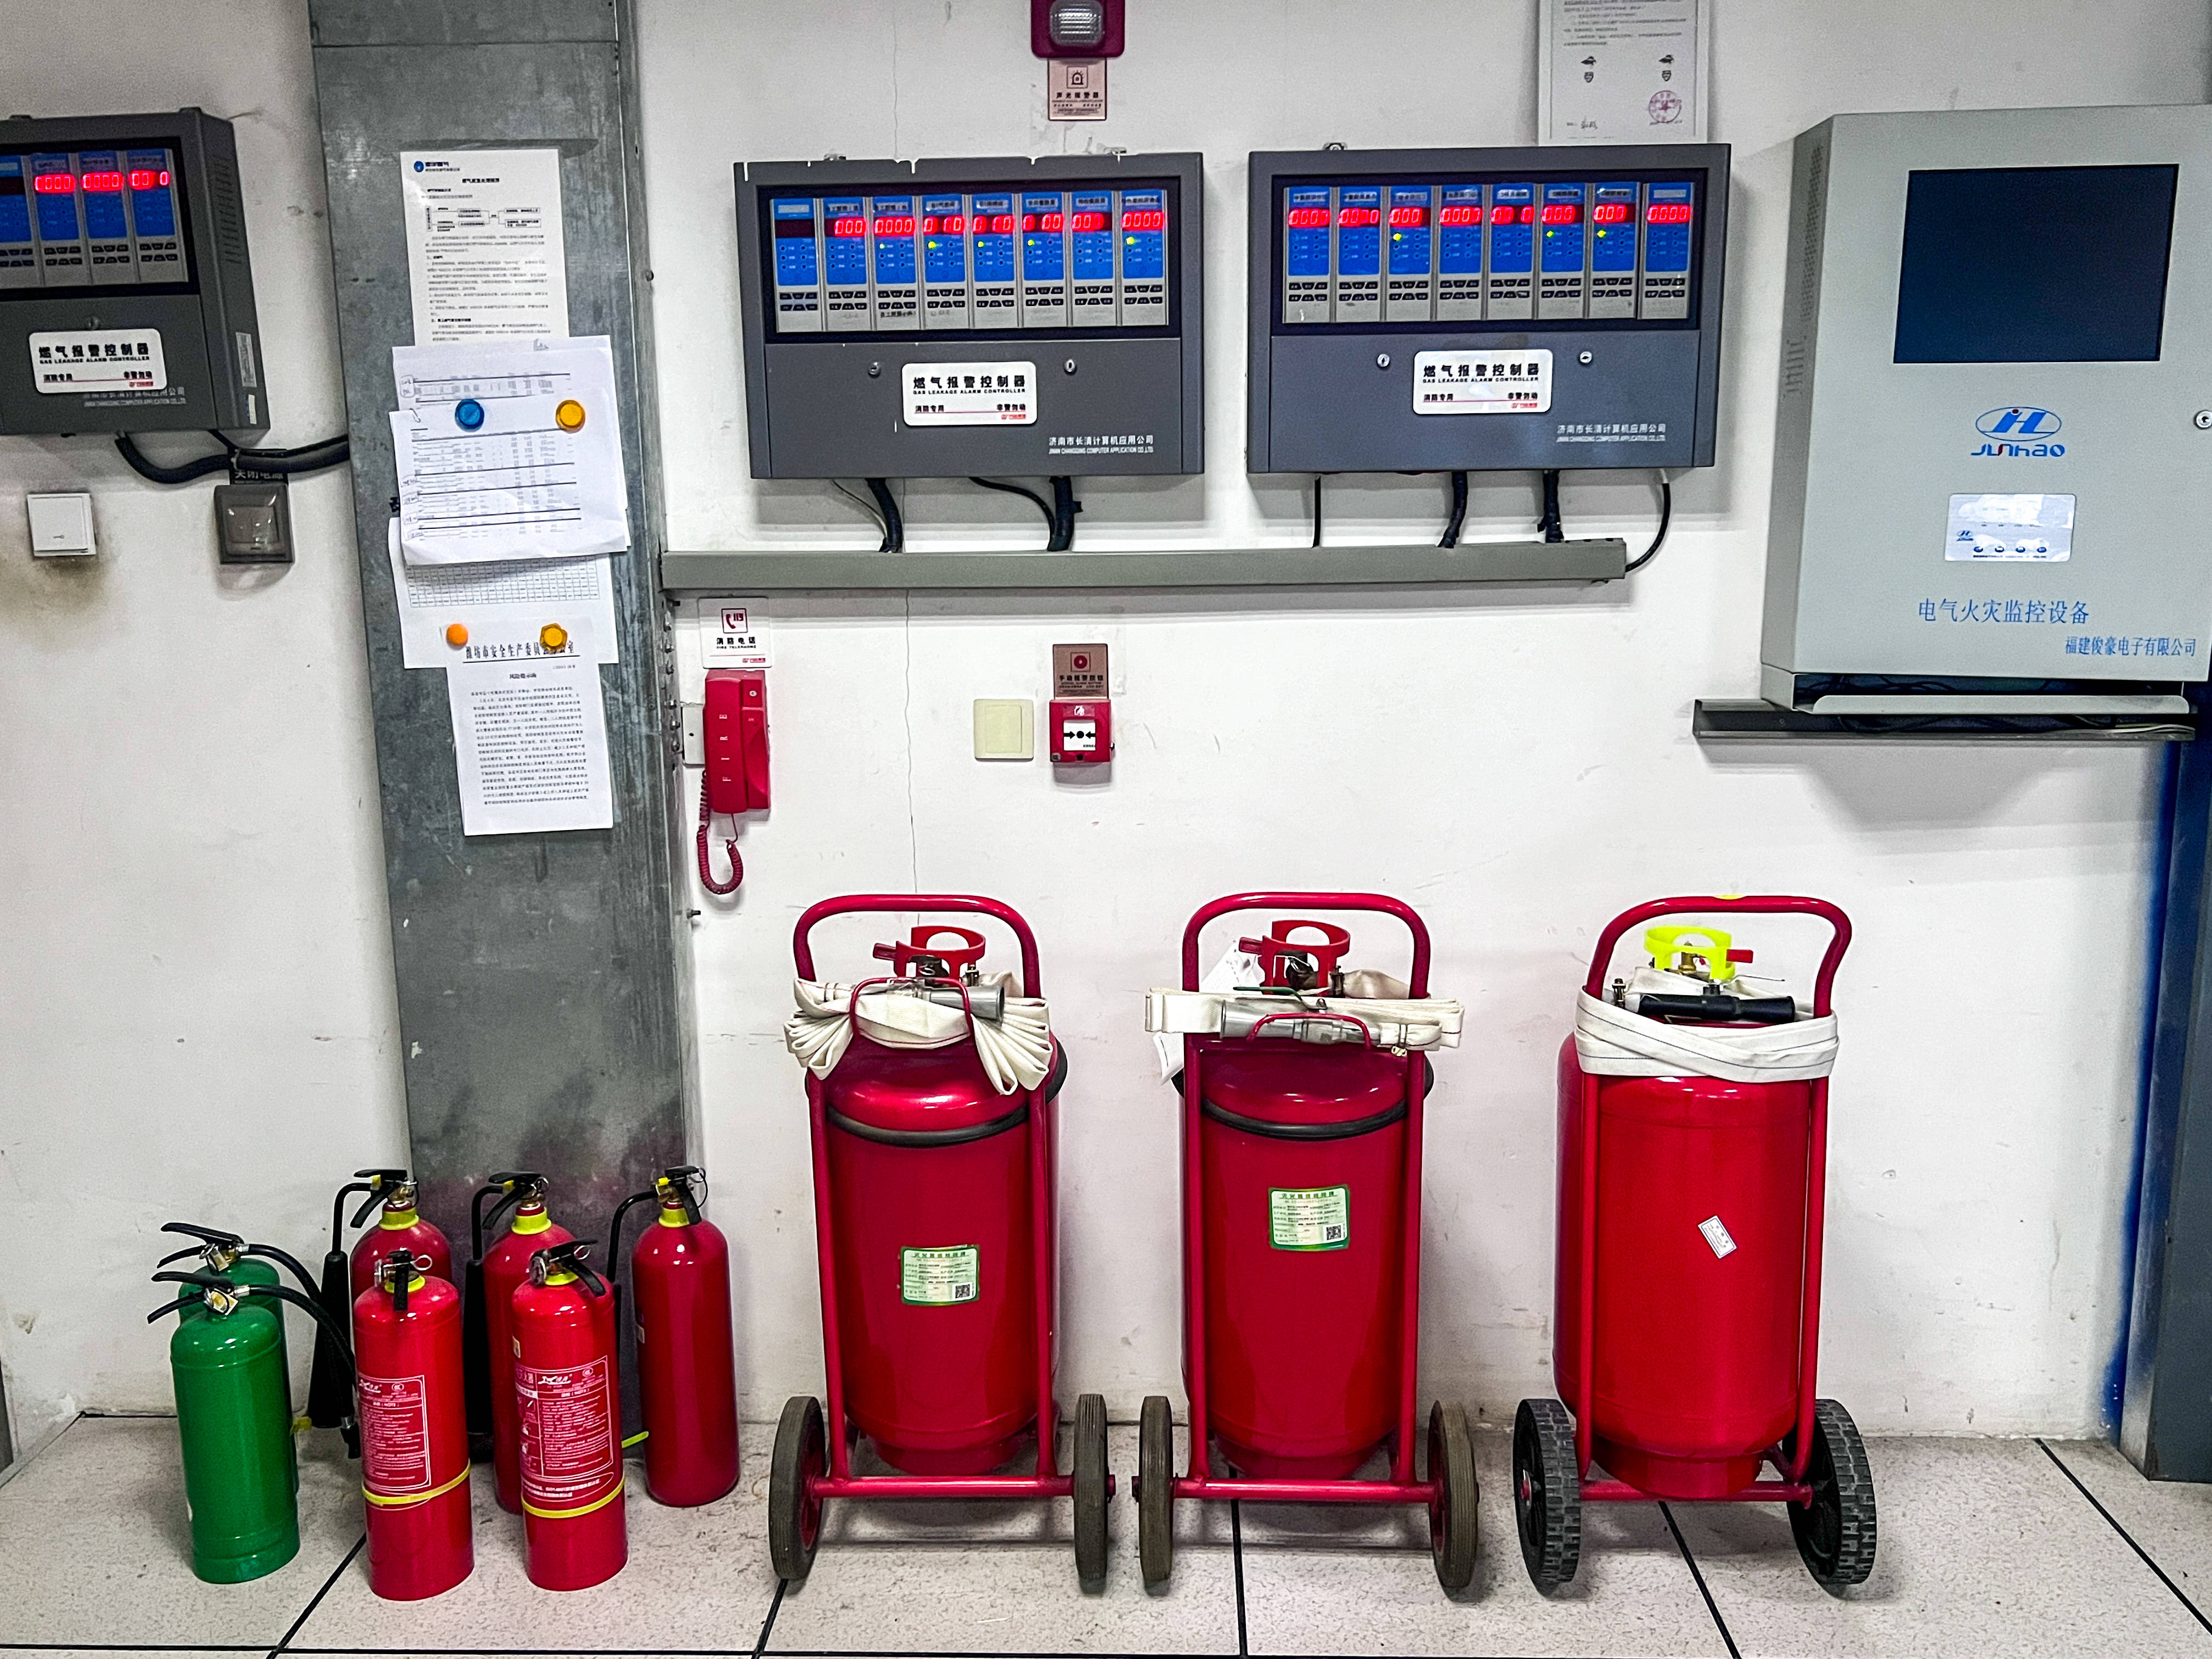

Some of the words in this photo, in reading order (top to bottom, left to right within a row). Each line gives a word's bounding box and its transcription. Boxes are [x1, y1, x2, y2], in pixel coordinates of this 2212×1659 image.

[38, 342, 149, 358] 燃气报警控制器
[1424, 363, 1539, 377] 燃气报警控制器
[913, 375, 1025, 389] 燃气报警控制器
[1918, 598, 2090, 624] 电气火灾监控设备
[716, 636, 755, 645] 消防电话
[2064, 636, 2196, 657] 福建俊豪电子有限公司
